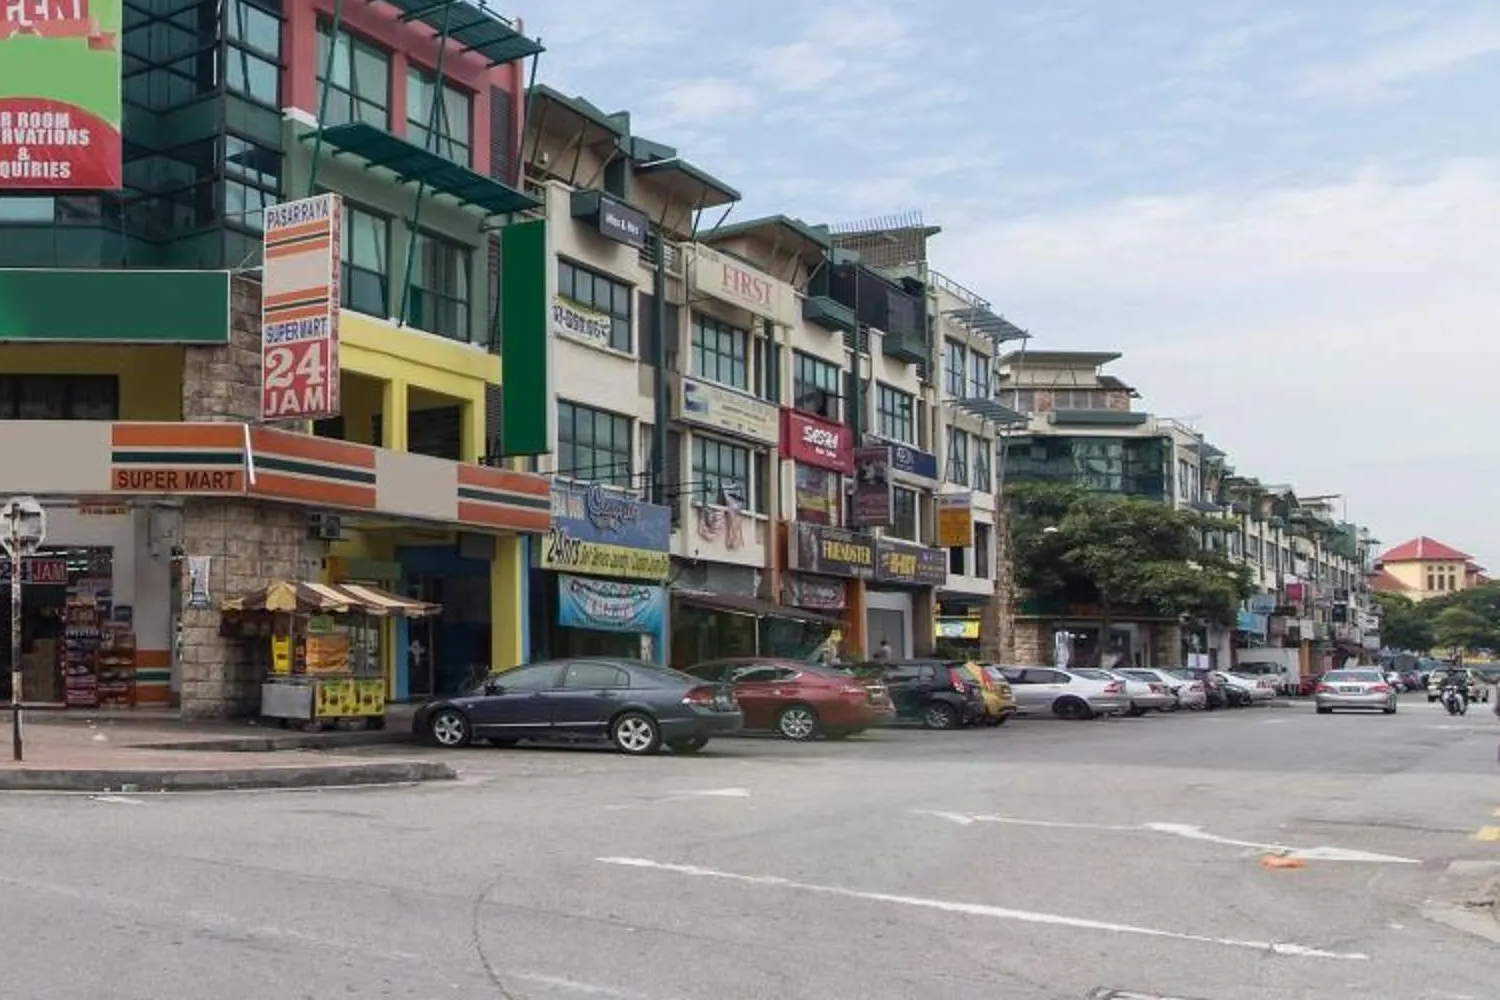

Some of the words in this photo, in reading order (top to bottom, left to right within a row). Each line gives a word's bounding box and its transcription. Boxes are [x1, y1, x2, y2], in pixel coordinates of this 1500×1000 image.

[17, 111, 70, 129] ROOM
[17, 146, 31, 161] &
[266, 205, 300, 230] PASAR
[301, 199, 329, 221] RAYA
[722, 262, 772, 305] FIRST
[265, 322, 300, 344] SUPER
[300, 316, 328, 340] MART
[265, 343, 326, 390] 24
[264, 384, 327, 417] JAM
[117, 469, 178, 491] SUPER
[185, 470, 237, 491] MART
[33, 561, 66, 581] JAM
